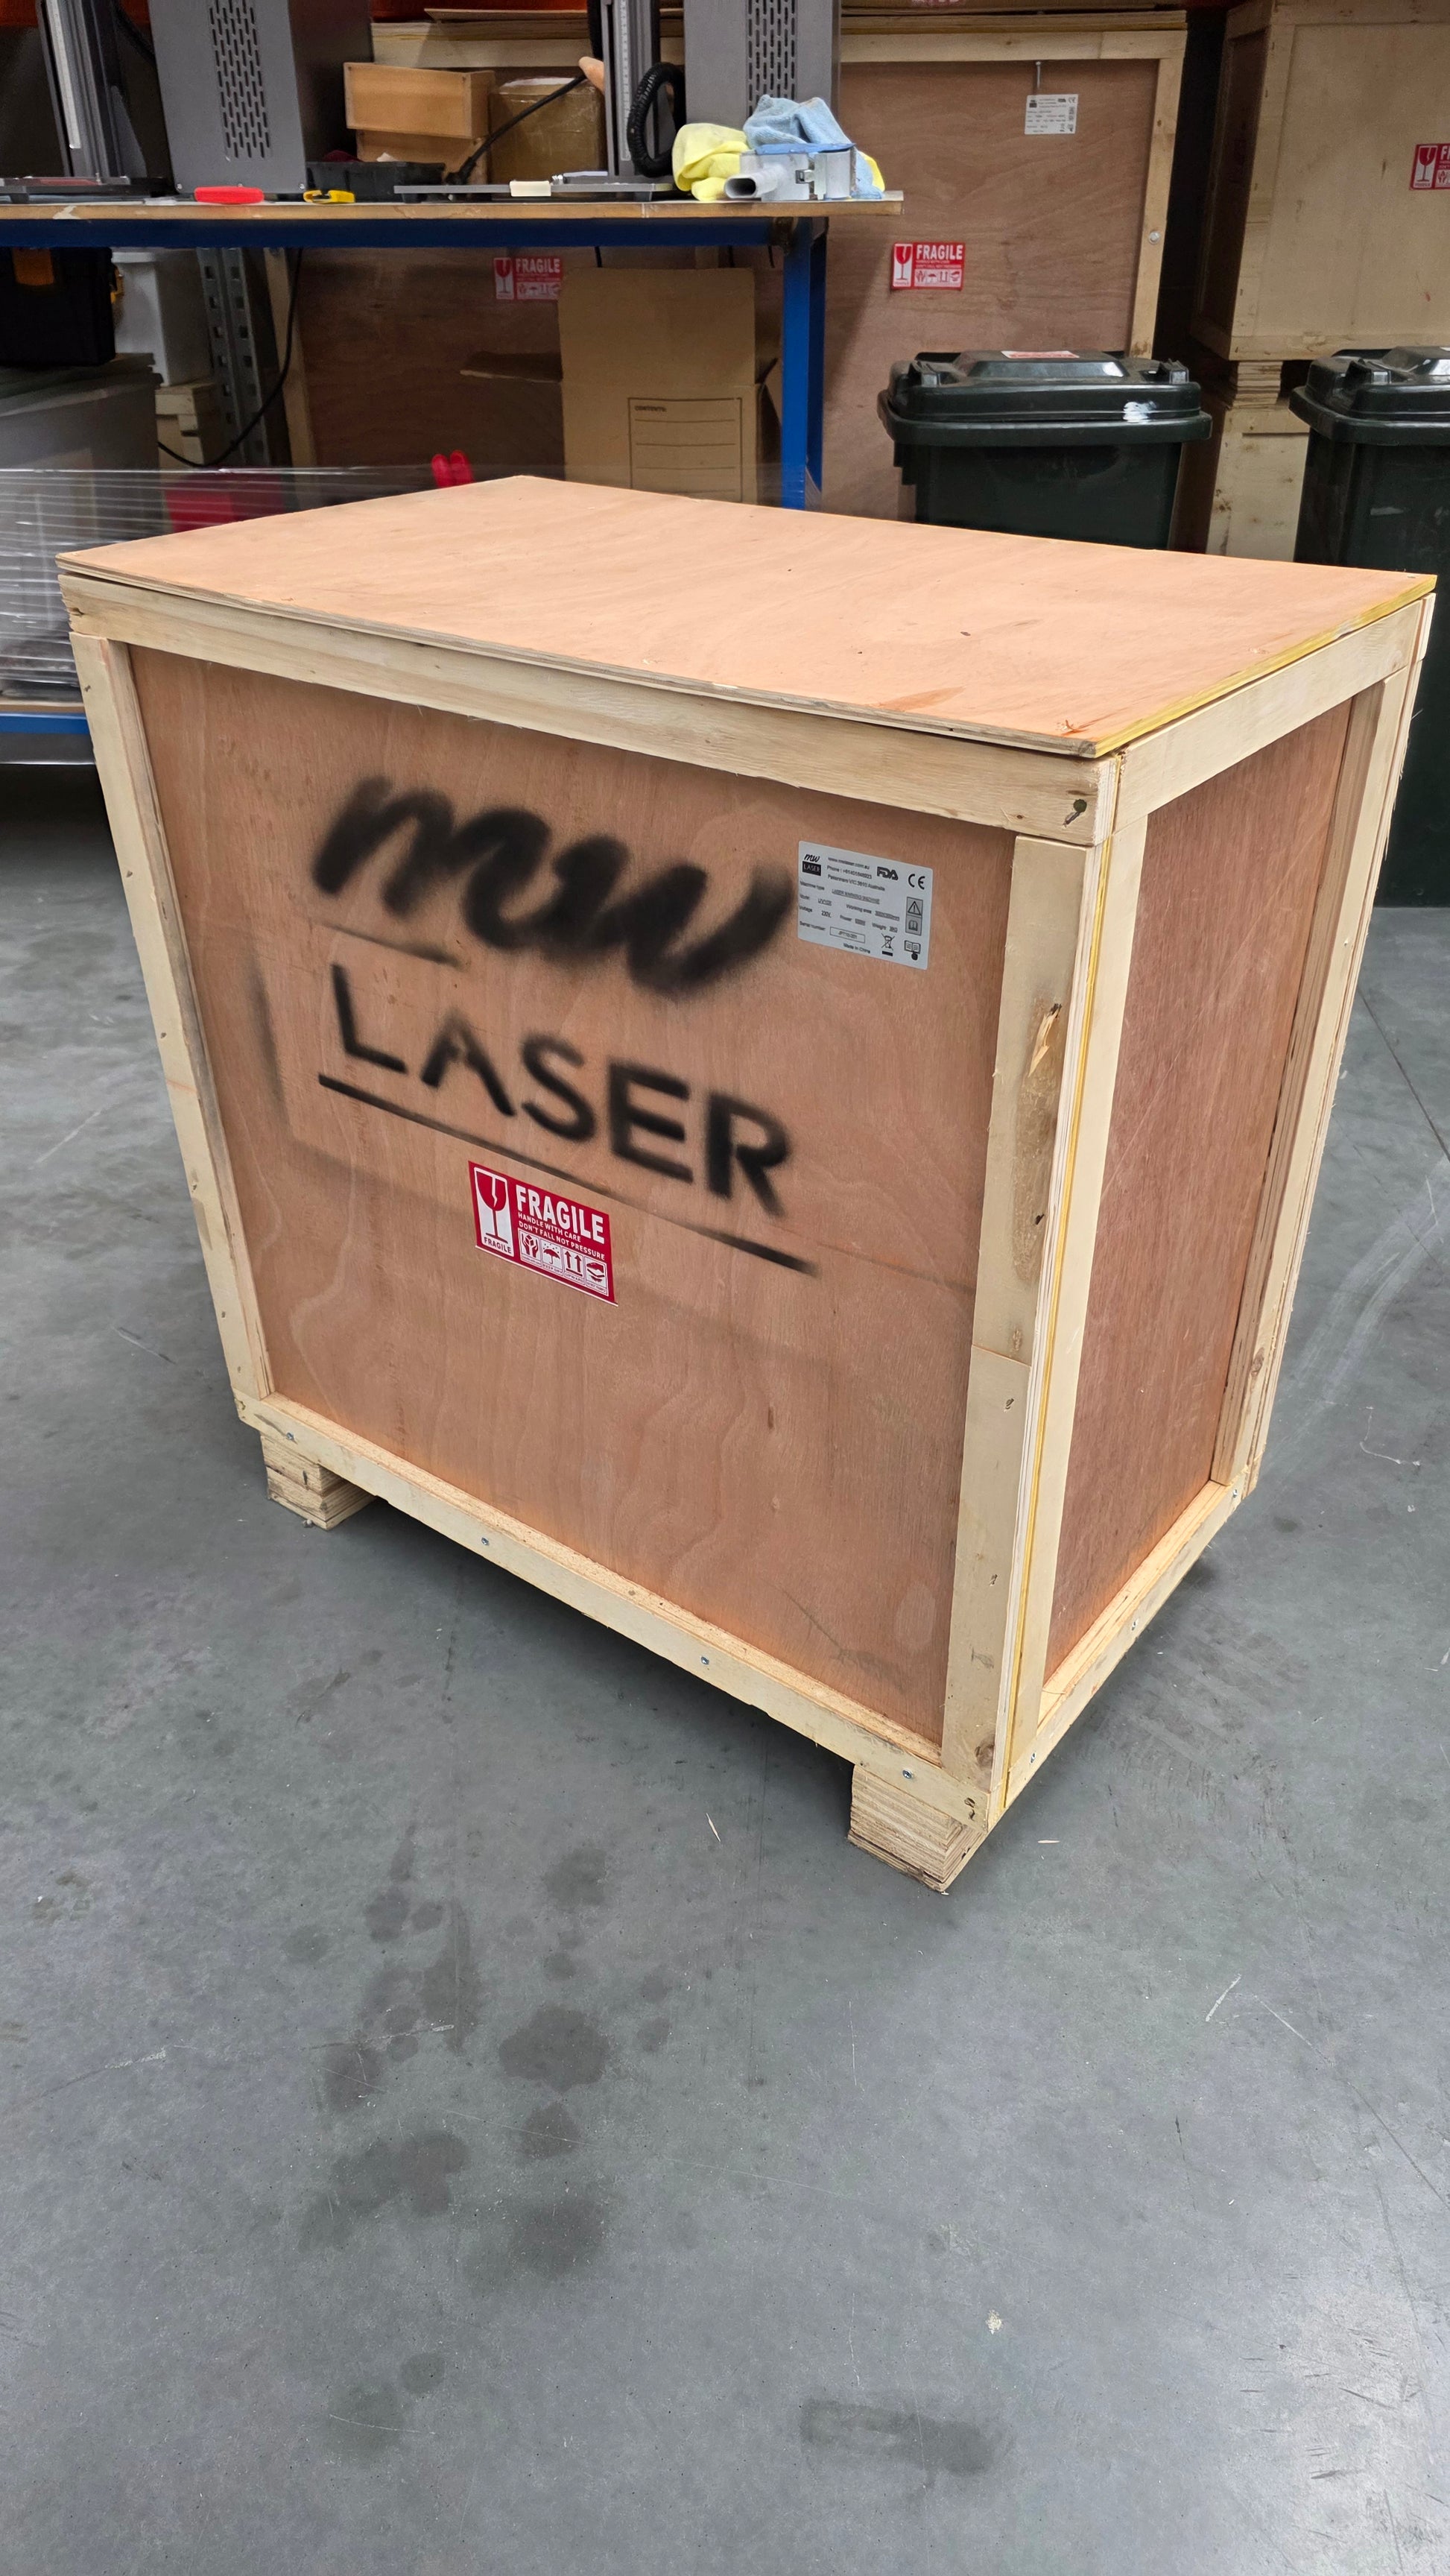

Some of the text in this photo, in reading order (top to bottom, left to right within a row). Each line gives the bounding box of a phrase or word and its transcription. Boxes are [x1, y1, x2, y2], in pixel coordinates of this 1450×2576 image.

[916, 244, 963, 260] FRAGILE
[515, 258, 561, 274] FRAGILE
[804, 853, 820, 863] mw
[804, 863, 820, 873] LASER
[877, 866, 899, 881] FDA
[908, 874, 925, 890] CE
[328, 960, 794, 1219] LASER
[516, 1184, 605, 1245] FRAGILE
[518, 1212, 581, 1243] HANDLE WITH CARE
[484, 1237, 512, 1254] FRAGILE
[519, 1221, 605, 1261] DON'T FALL NOT PRESSURE
